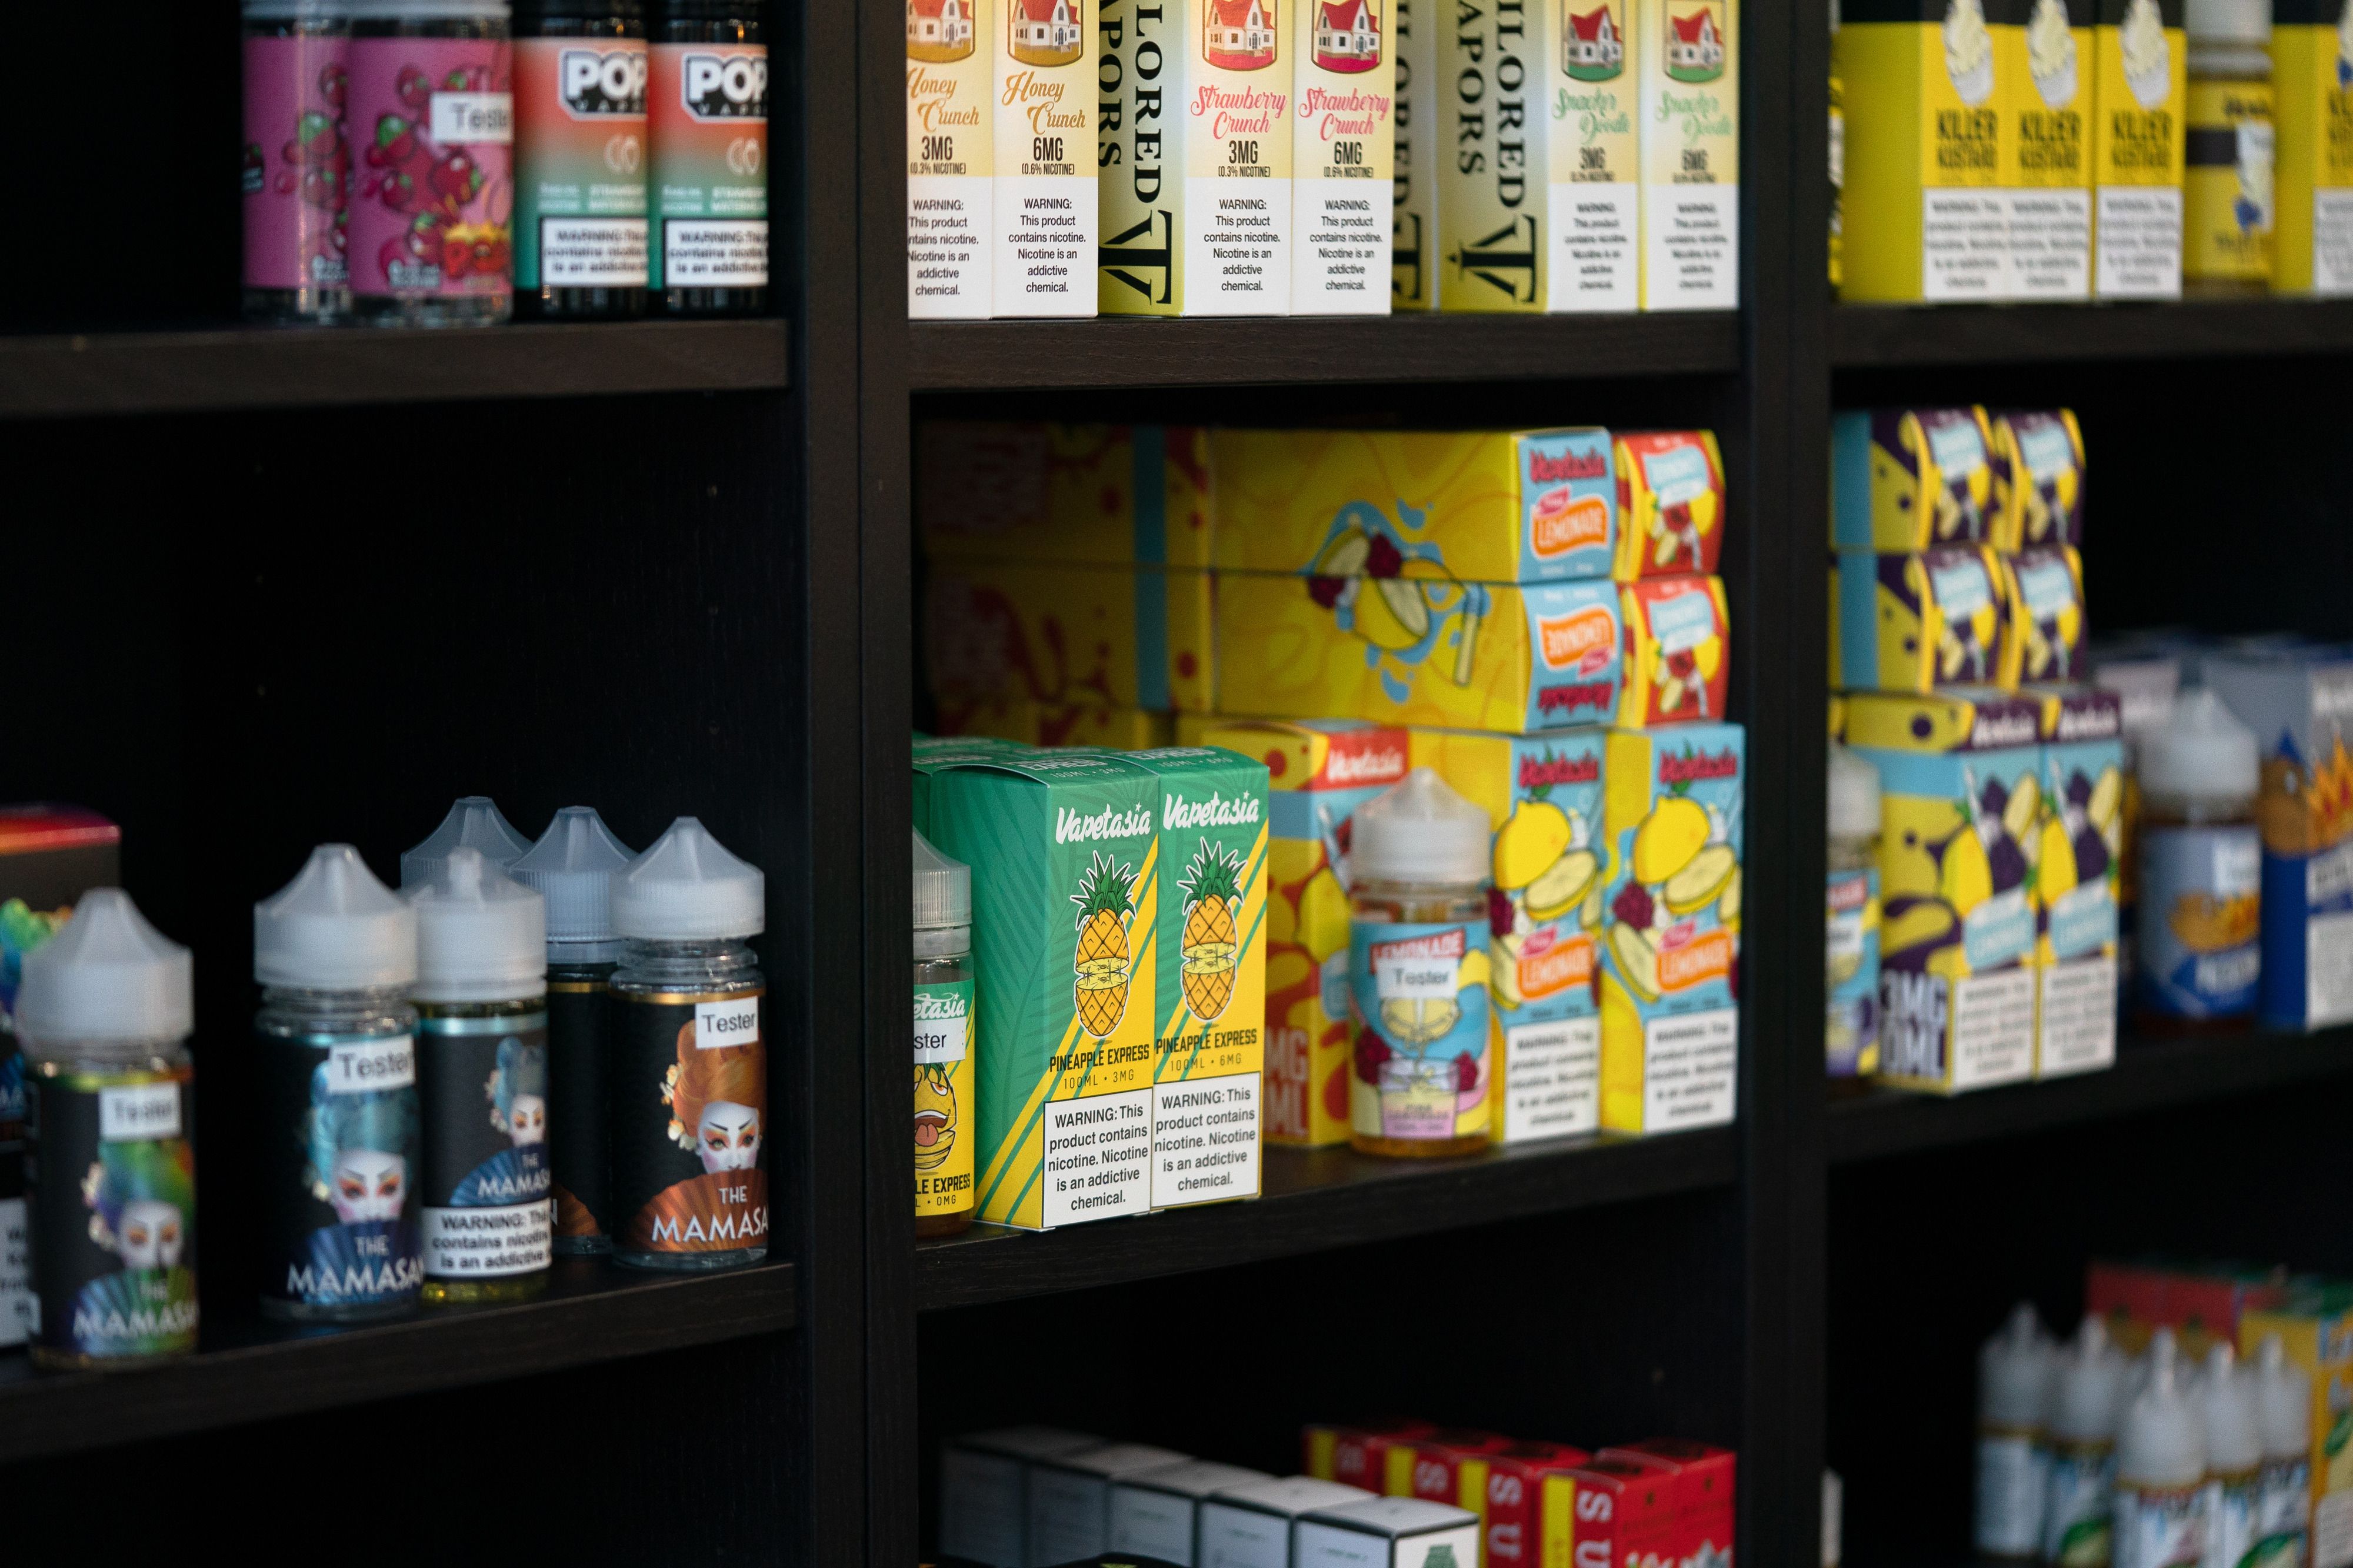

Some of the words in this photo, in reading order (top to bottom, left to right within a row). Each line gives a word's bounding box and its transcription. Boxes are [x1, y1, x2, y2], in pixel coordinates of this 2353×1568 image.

[1002, 71, 1065, 106] Honey
[1191, 84, 1287, 119] Strawberry
[1299, 88, 1390, 121] Strawberry
[918, 98, 979, 132] Crunch
[1027, 101, 1086, 135] Crunch
[1213, 111, 1271, 140] Crunch
[1319, 112, 1375, 141] Crunch
[922, 135, 953, 161] 3MG
[1033, 137, 1063, 161] 6MG
[1228, 141, 1258, 164] 3MG
[1334, 142, 1362, 165] 6MG
[910, 162, 932, 175] (0.3%
[933, 162, 966, 175] NICOTINE)
[1022, 163, 1042, 175] (0.6%
[1044, 163, 1075, 175] NICOTINE)
[1218, 166, 1238, 177] (0.3%
[1239, 166, 1271, 178] NICOTINE)
[913, 199, 964, 211] WARNING:
[1024, 198, 1072, 209] WARNING:
[1219, 199, 1267, 210] WARNING:
[1325, 199, 1370, 211] WARNING:
[909, 216, 929, 228] This
[931, 216, 968, 229] product
[1020, 215, 1039, 226] This
[1041, 215, 1076, 228] product
[1215, 216, 1234, 226] This
[1237, 216, 1270, 228] product
[1321, 216, 1339, 226] This
[1341, 216, 1373, 228] product
[940, 233, 979, 245] nicotine.
[1008, 232, 1047, 242] contains
[1049, 232, 1086, 242] nicotine.
[1204, 233, 1242, 242] contains
[1244, 233, 1280, 242] nicotine.
[1310, 233, 1346, 243] contains
[1348, 233, 1382, 243] nicotine.
[948, 250, 956, 261] is
[958, 252, 969, 261] an
[1018, 248, 1055, 259] Nicotine
[1057, 248, 1064, 259] is
[1066, 251, 1077, 259] an
[1213, 248, 1249, 259] Nicotine
[1252, 248, 1259, 259] is
[1261, 251, 1272, 259] an
[1318, 248, 1353, 259] Nicotine
[1355, 248, 1362, 259] is
[1364, 250, 1374, 259] an
[916, 267, 959, 279] addictive
[1028, 265, 1068, 276] addictive
[1223, 264, 1262, 275] addictive
[1327, 264, 1365, 275] addictive
[915, 284, 960, 295] chemical.
[1026, 282, 1069, 293] chemical.
[1221, 281, 1263, 291] chemical.
[1325, 281, 1366, 291] chemical.
[1163, 790, 1259, 830] Vapetasia
[1056, 801, 1151, 845] Vapetasia
[702, 1012, 756, 1033] Tester
[1156, 1033, 1211, 1054] PINEAPPLE
[1215, 1028, 1257, 1048] EXPRESS
[1049, 1050, 1105, 1072] PINEAPPLE
[1108, 1044, 1149, 1065] EXPRESS
[1171, 1057, 1205, 1071] 100ML
[1220, 1053, 1242, 1066] 6MG
[1064, 1075, 1098, 1089] 100ML
[1113, 1069, 1134, 1083] 3MG
[1162, 1090, 1225, 1109] WARNING:
[1227, 1087, 1251, 1102] This
[1055, 1107, 1117, 1128] WARNING:
[1119, 1104, 1143, 1119] This
[1156, 1113, 1203, 1135] product
[1207, 1108, 1255, 1125] contains
[1049, 1132, 1096, 1154] product
[1099, 1125, 1148, 1143] contains
[1155, 1136, 1206, 1152] nicotine.
[1209, 1129, 1256, 1145] Nicotine
[1048, 1154, 1098, 1172] nicotine.
[1102, 1146, 1148, 1164] Nicotine
[1164, 1159, 1174, 1172] is
[1177, 1159, 1191, 1170] an
[1195, 1150, 1247, 1168] addictive
[934, 1173, 970, 1193] EXPRESS
[1056, 1178, 1066, 1192] is
[1070, 1178, 1084, 1190] an
[1088, 1168, 1140, 1187] addictive
[1178, 1172, 1233, 1191] chemical.
[719, 1185, 748, 1206] THE
[1071, 1189, 1126, 1210] chemical.
